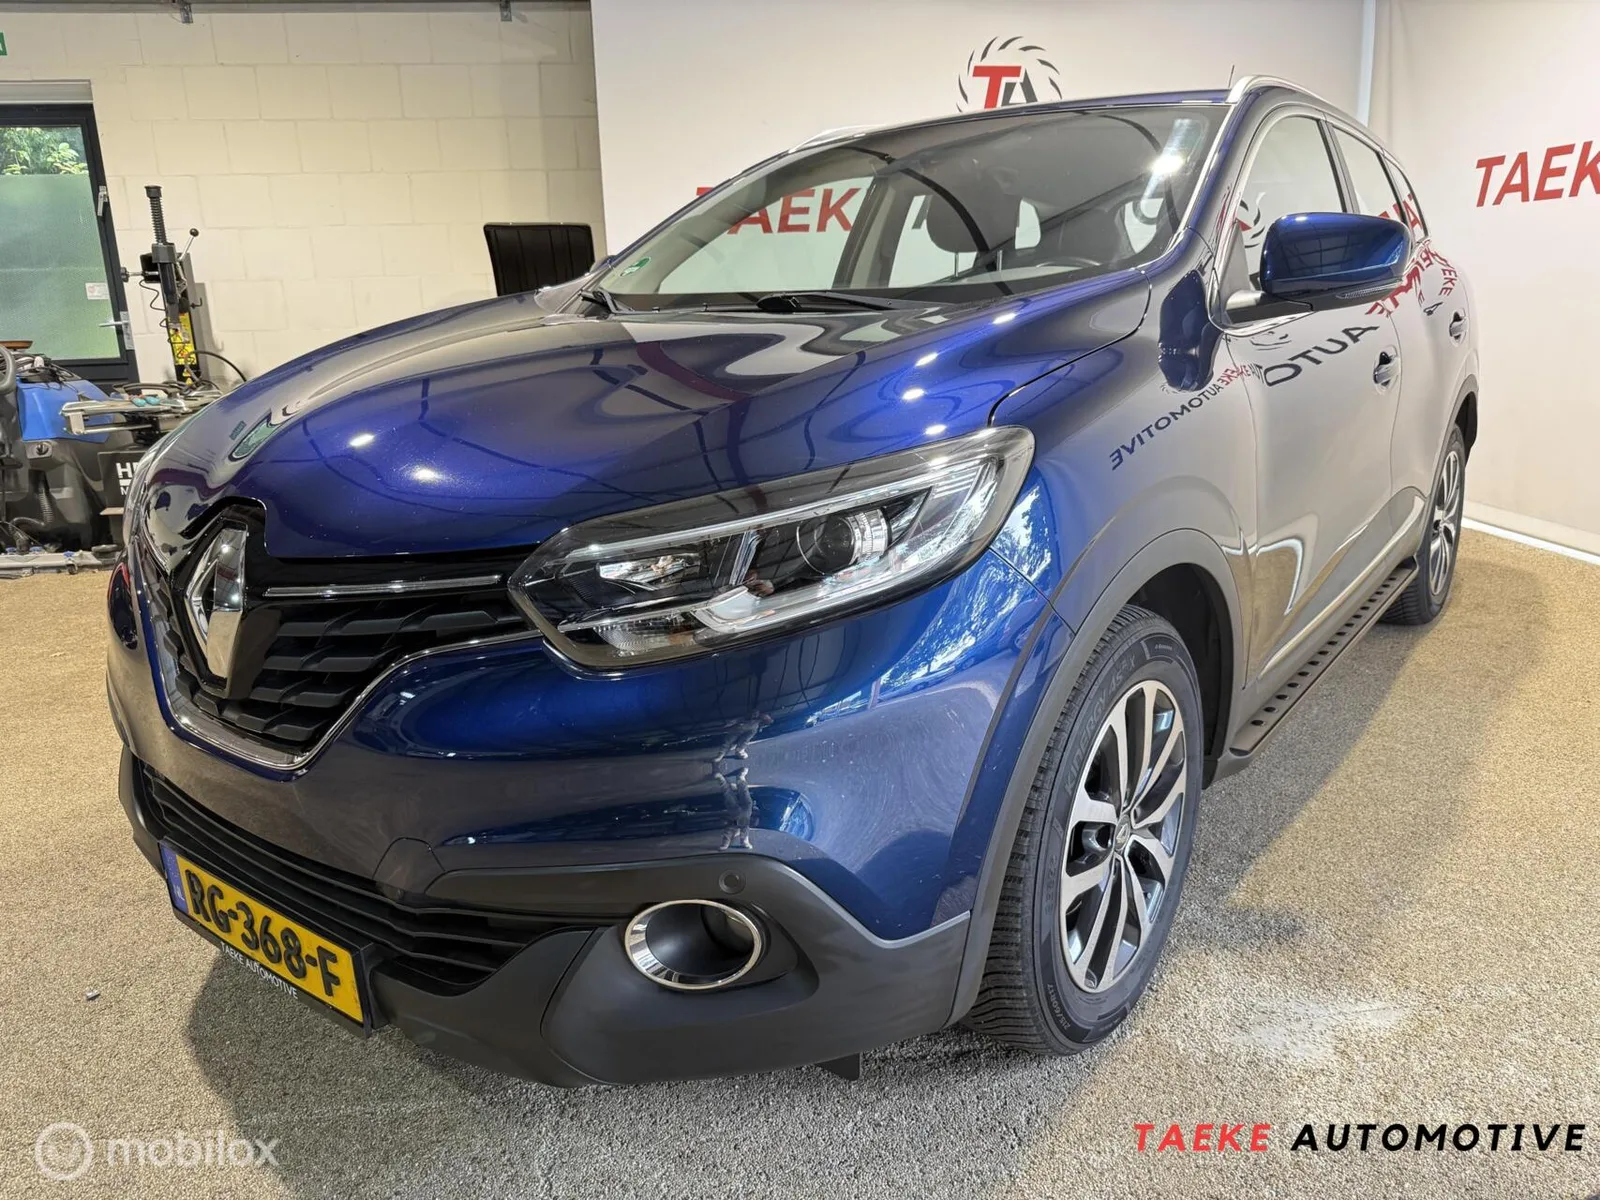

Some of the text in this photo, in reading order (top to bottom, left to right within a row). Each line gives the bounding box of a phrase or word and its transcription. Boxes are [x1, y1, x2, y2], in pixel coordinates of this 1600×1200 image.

[697, 186, 861, 235] AEK
[185, 869, 341, 997] RG-368-F
[220, 942, 298, 999] TAEKE AUTOMOTIVE
